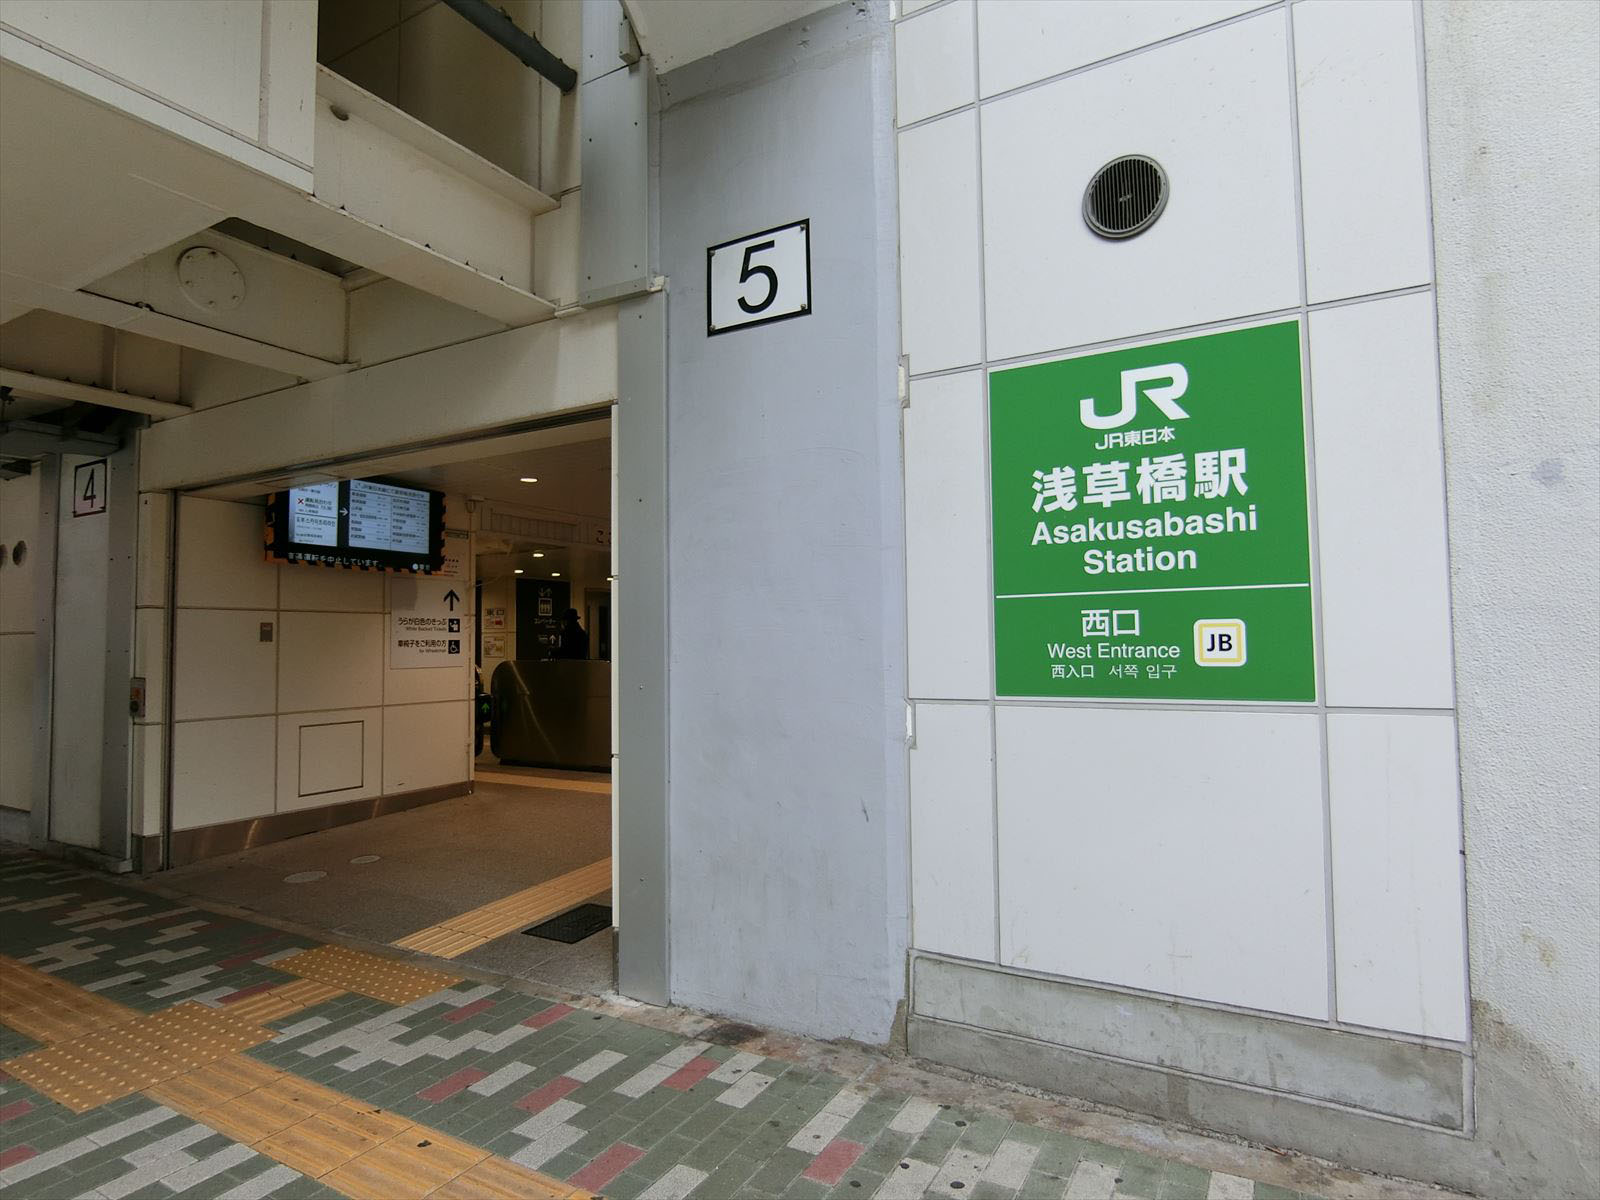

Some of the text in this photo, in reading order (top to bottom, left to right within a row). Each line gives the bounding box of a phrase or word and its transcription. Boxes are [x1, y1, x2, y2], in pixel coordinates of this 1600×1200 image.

[737, 239, 778, 314] 5
[1079, 362, 1191, 430] JR
[1094, 425, 1176, 450] JR東日本
[83, 468, 96, 508] 4
[1031, 447, 1249, 513] 浅草橋駅
[1031, 504, 1257, 546] Asakusabashi
[1083, 546, 1197, 575] Station
[1081, 608, 1140, 637] 西口
[1047, 642, 1181, 659] West Entrance
[1206, 633, 1233, 652] JB
[1051, 664, 1177, 679] 西入口 서쪽 입구
